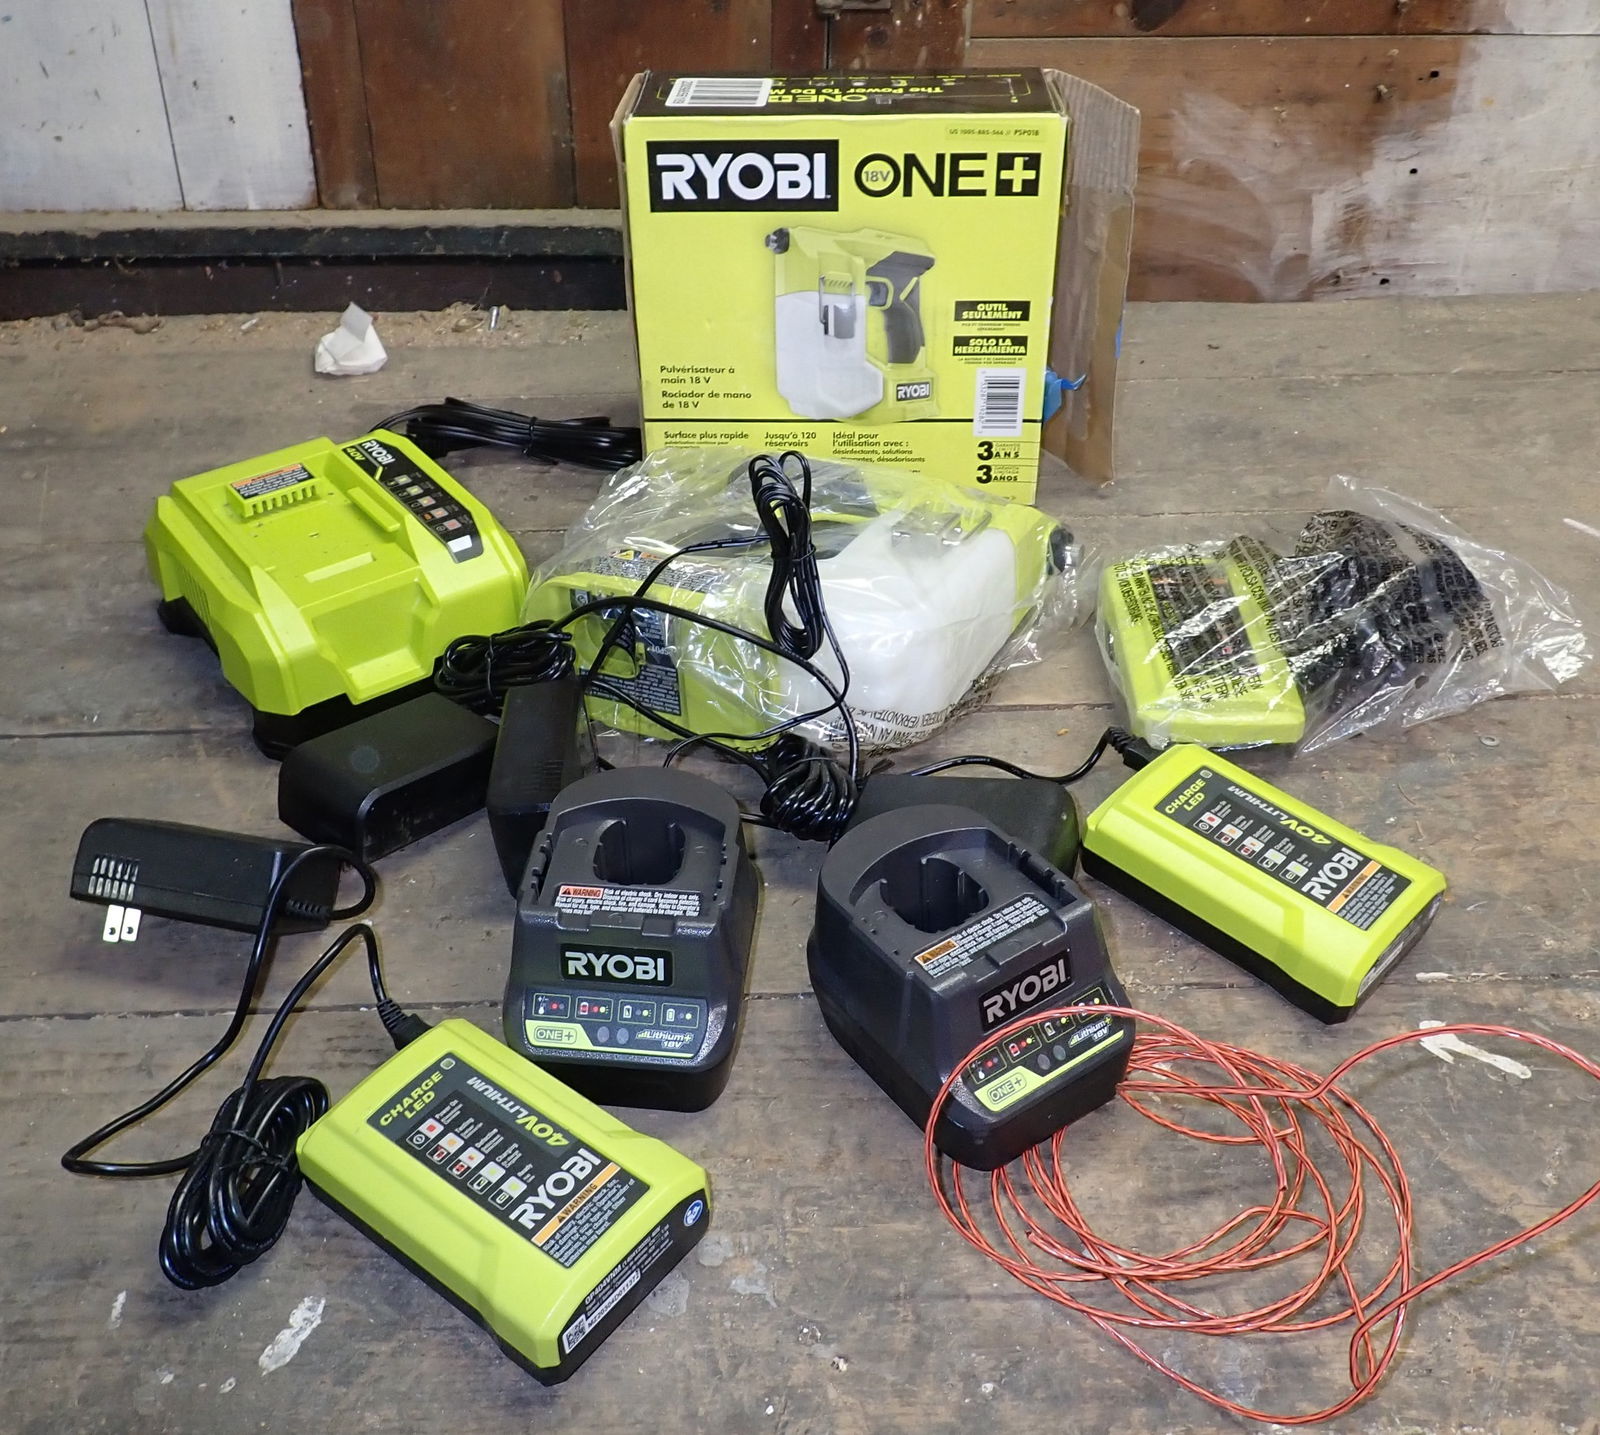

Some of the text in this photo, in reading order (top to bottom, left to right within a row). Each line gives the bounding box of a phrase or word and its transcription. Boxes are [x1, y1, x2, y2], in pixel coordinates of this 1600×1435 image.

[656, 153, 826, 200] RYOBI
[864, 169, 891, 183] 18V
[962, 311, 1022, 319] SEULEMENT
[977, 303, 1008, 311] OUTIL
[954, 346, 1026, 354] HERRAMIENTA
[969, 338, 1012, 346] SOLO LA
[660, 365, 735, 374] Pulvérisateur à
[661, 376, 711, 384] main 18 V
[662, 390, 705, 398] Rociador
[708, 390, 720, 398] de
[897, 383, 930, 399] RYOBI
[662, 401, 699, 409] de 18 V
[664, 431, 749, 441] Surface plus rapide
[765, 439, 808, 447] réservoirs
[858, 433, 879, 441] pour
[362, 440, 396, 466] RYOBI
[977, 441, 994, 461] 3
[976, 464, 993, 484] 3
[1165, 778, 1206, 814] CHARGE
[1183, 792, 1205, 811] LED
[1227, 785, 1332, 845] 40V LITHIUM
[1301, 847, 1364, 900] RYOBI
[572, 888, 600, 897] WARNING
[565, 951, 665, 981] RYOBI
[983, 958, 1066, 1023] RYOBI
[536, 1028, 574, 1043] ONE+
[1093, 1027, 1108, 1042] 18V
[662, 1040, 683, 1049] 18V
[380, 1071, 443, 1126] CHARGE
[466, 1076, 529, 1119] LITHIUM
[990, 1077, 1023, 1101] ONE+
[404, 1091, 436, 1119] LED
[515, 1116, 569, 1147] 40V
[508, 1148, 601, 1230] RYOBI
[563, 1183, 598, 1217] WARNING
